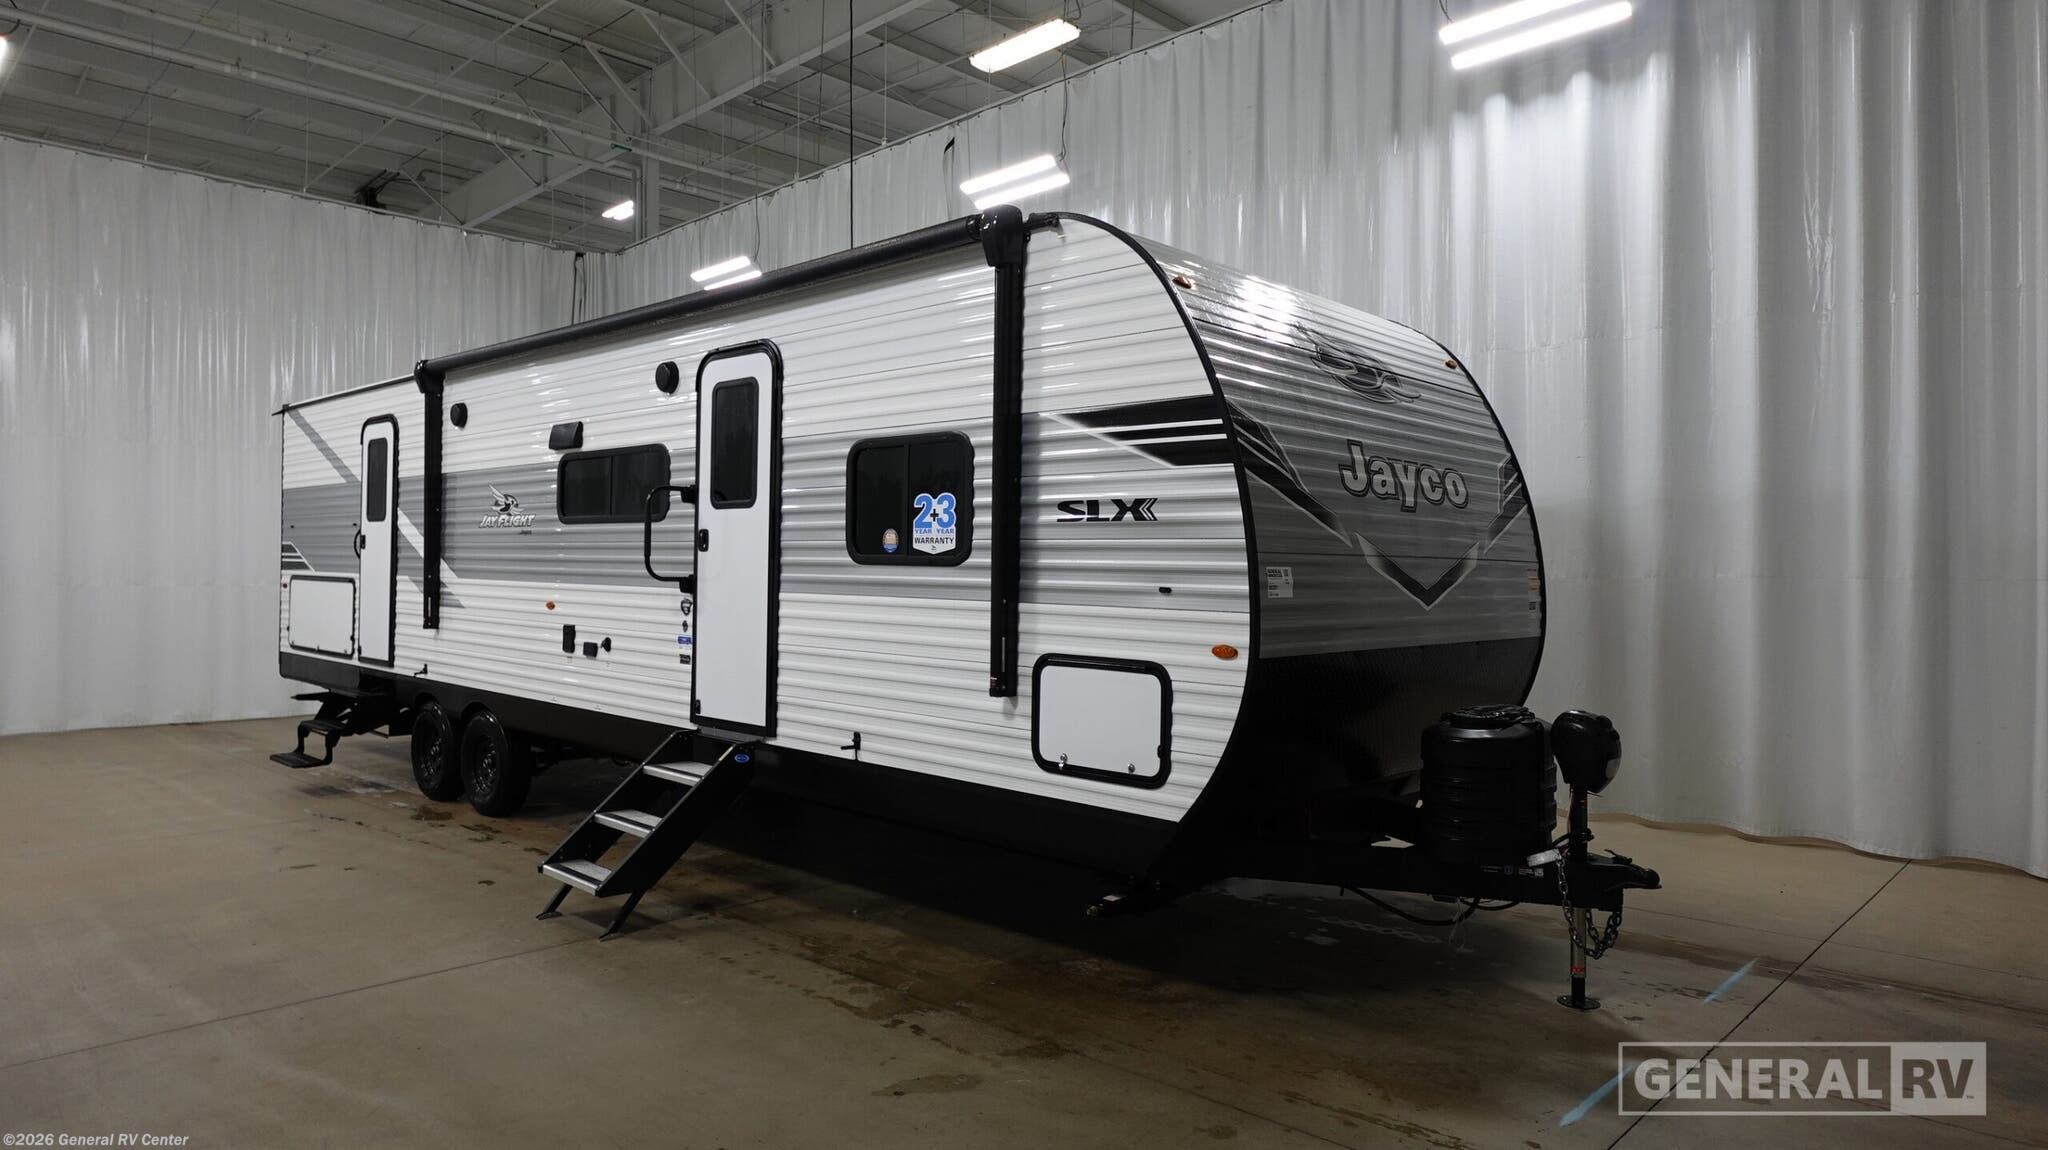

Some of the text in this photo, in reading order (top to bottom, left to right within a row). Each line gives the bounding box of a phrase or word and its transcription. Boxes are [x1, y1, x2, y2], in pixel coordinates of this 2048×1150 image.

[1338, 439, 1469, 513] Jayco
[1057, 498, 1158, 522] SLX
[479, 514, 536, 528] JAY FLIGHT
[914, 537, 955, 545] WARRANTY
